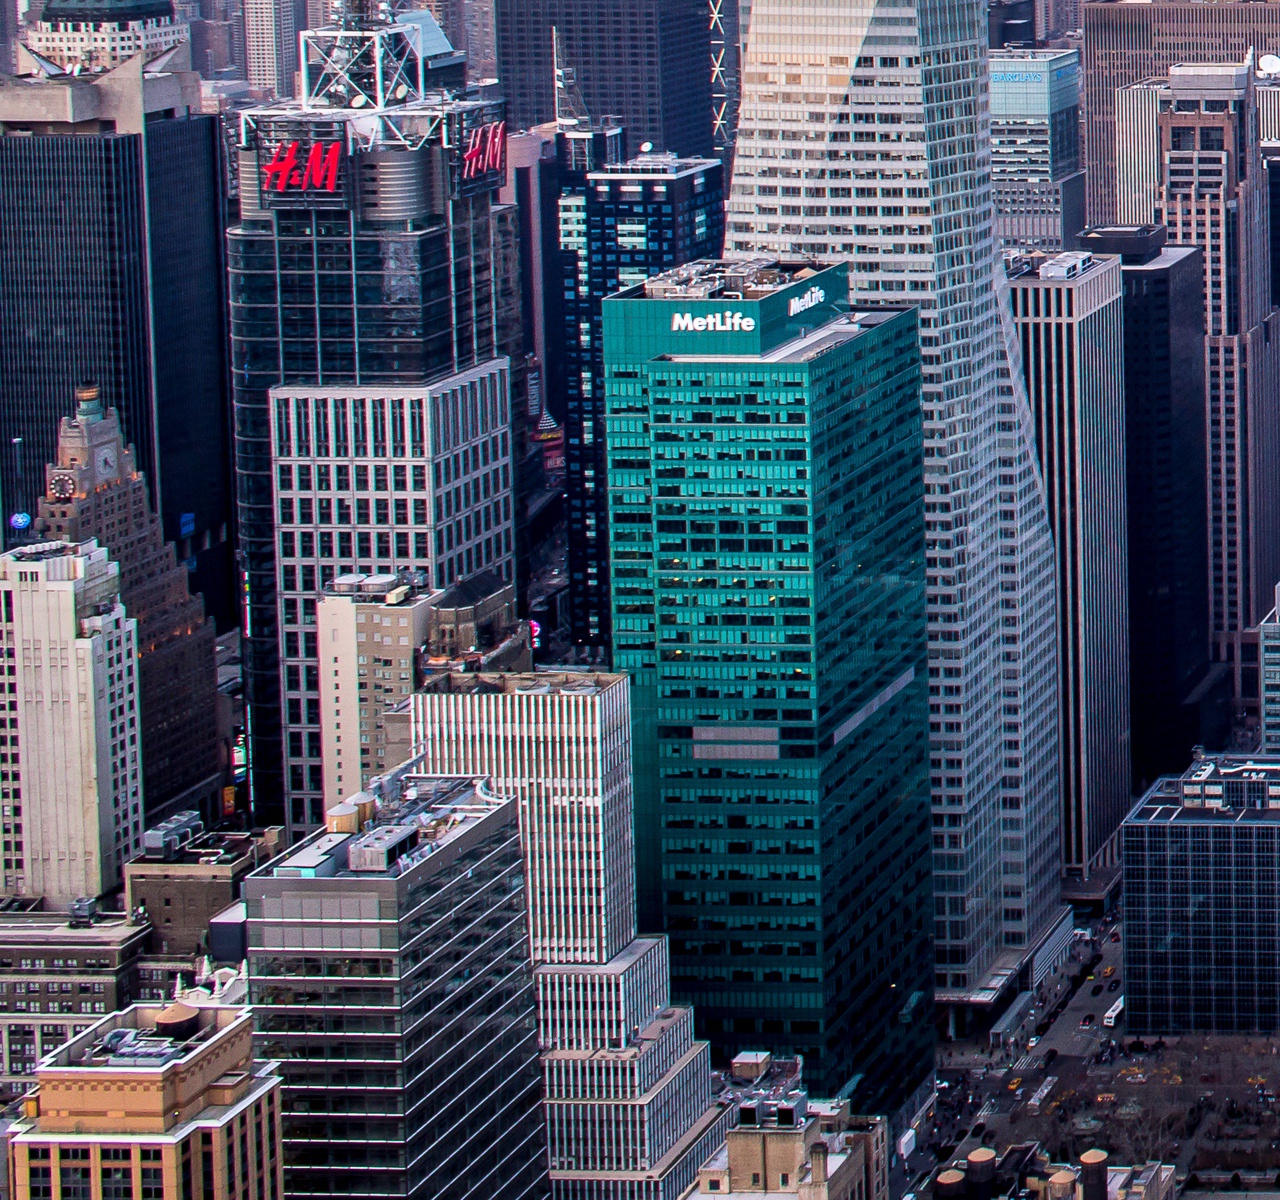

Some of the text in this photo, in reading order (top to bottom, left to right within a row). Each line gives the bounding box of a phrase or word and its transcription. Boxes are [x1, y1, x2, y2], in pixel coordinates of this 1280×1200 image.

[992, 72, 1042, 82] BARCLAYS
[463, 121, 505, 179] H&M
[262, 141, 341, 192] H&M
[788, 285, 825, 317] MetLife
[672, 311, 755, 332] MetLife
